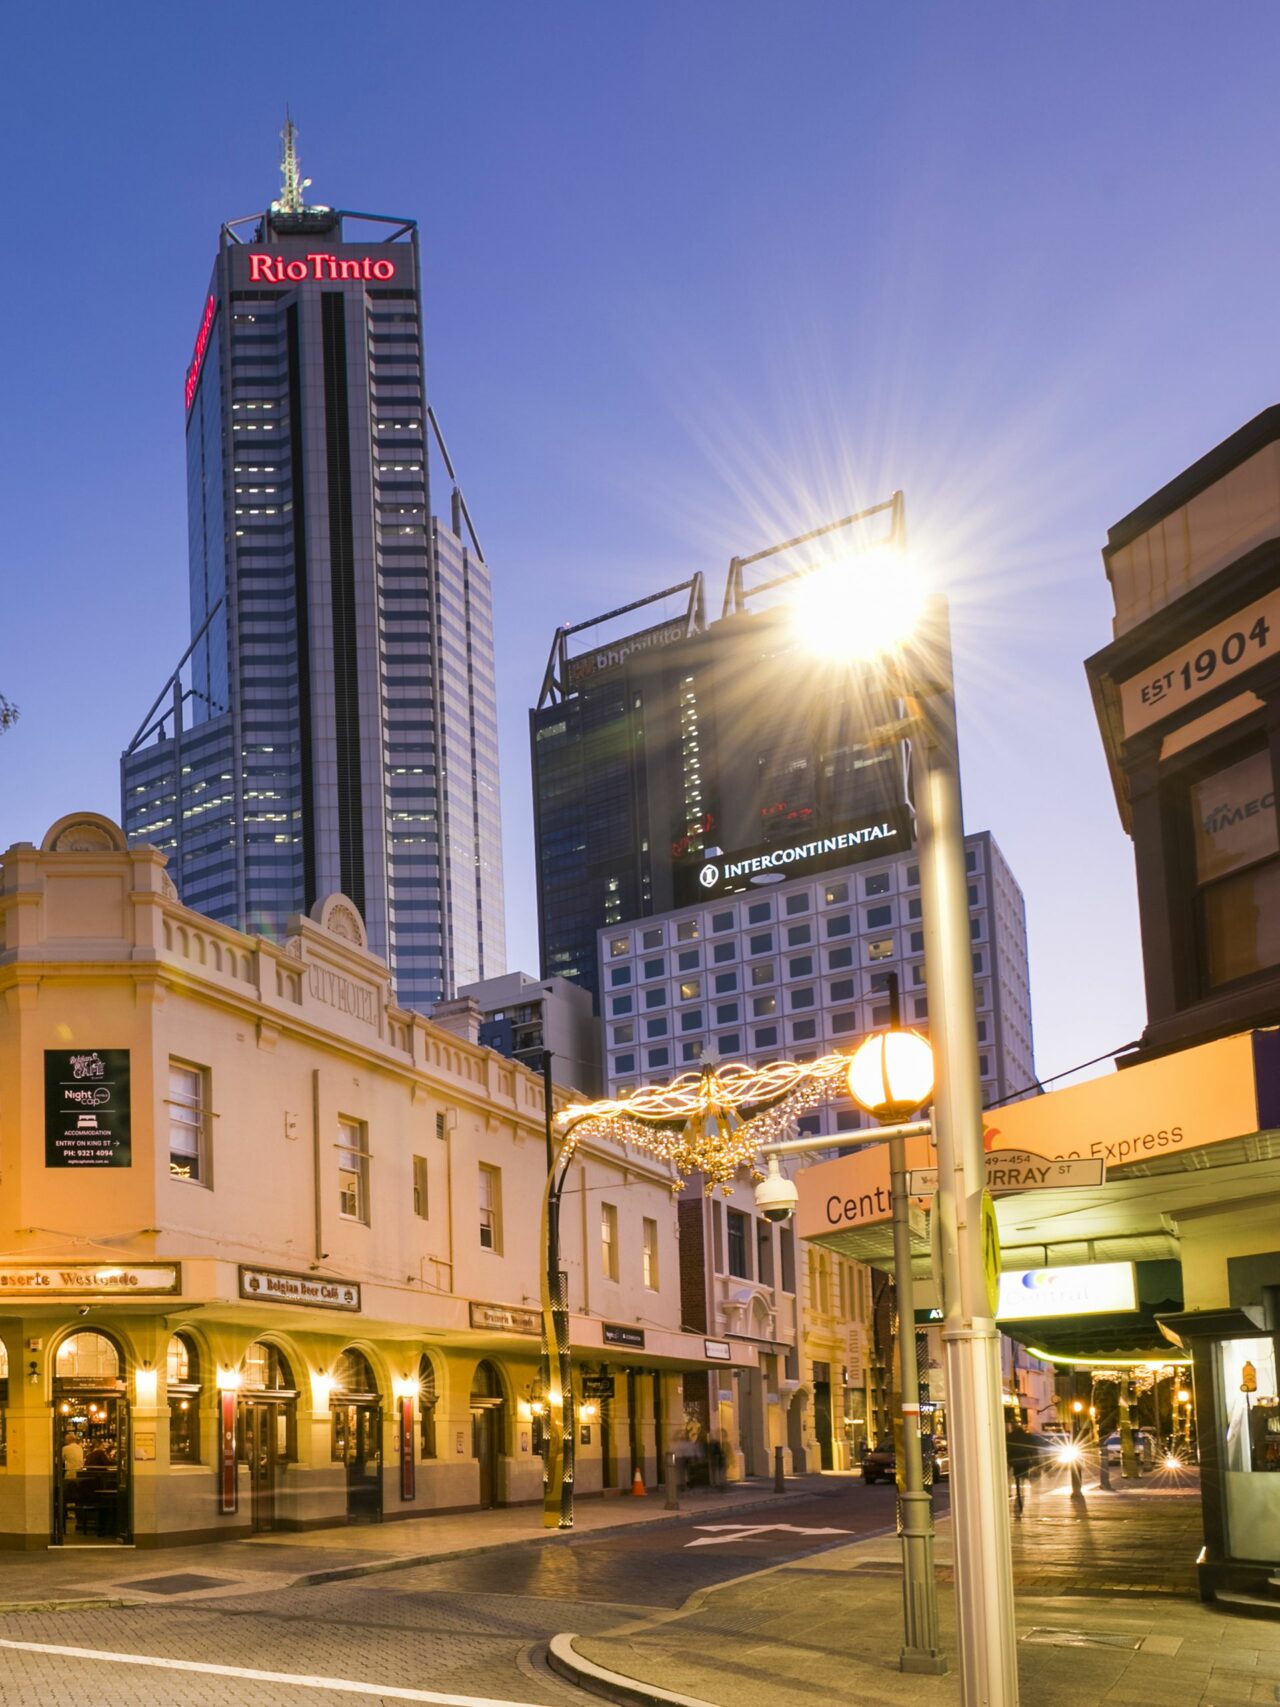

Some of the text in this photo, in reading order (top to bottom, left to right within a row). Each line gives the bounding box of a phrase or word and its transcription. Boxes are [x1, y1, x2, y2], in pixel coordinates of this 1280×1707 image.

[248, 253, 396, 283] RioTinto
[596, 627, 686, 672] bhpbillito
[1140, 615, 1270, 705] EST 1904
[723, 823, 897, 879] INTERCONTINENTAL
[308, 964, 377, 1027] CITY HOTEL
[64, 1090, 93, 1102] Night
[81, 1098, 101, 1107] cap
[1090, 1127, 1184, 1162] Express
[986, 1164, 1072, 1186] URRAY ST
[826, 1186, 894, 1225] Centr
[266, 1278, 299, 1295] Belgian
[300, 1283, 319, 1297] Beer
